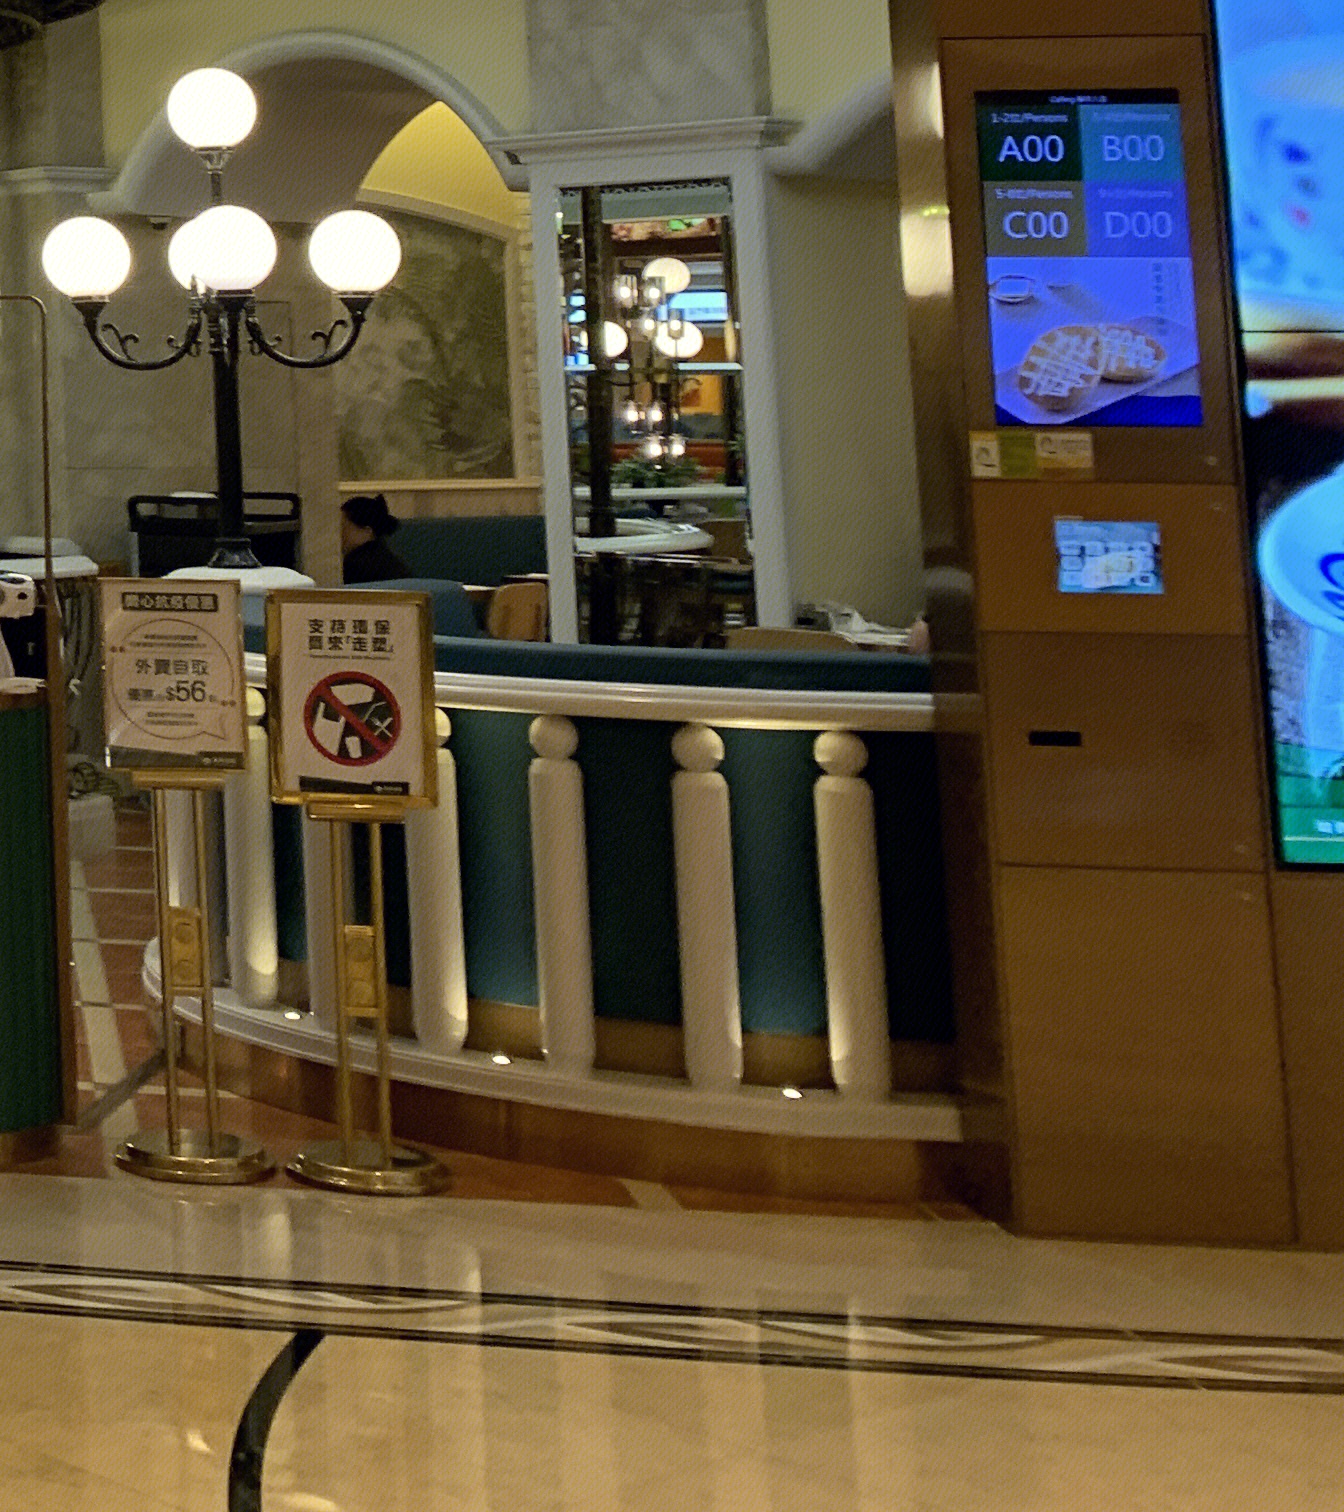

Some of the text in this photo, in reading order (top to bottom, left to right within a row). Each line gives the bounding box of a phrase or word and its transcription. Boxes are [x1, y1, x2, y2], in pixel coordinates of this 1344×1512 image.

[999, 134, 1065, 163] A00
[1102, 134, 1165, 163] B00
[1003, 210, 1070, 240] C00
[1104, 210, 1173, 240] D00
